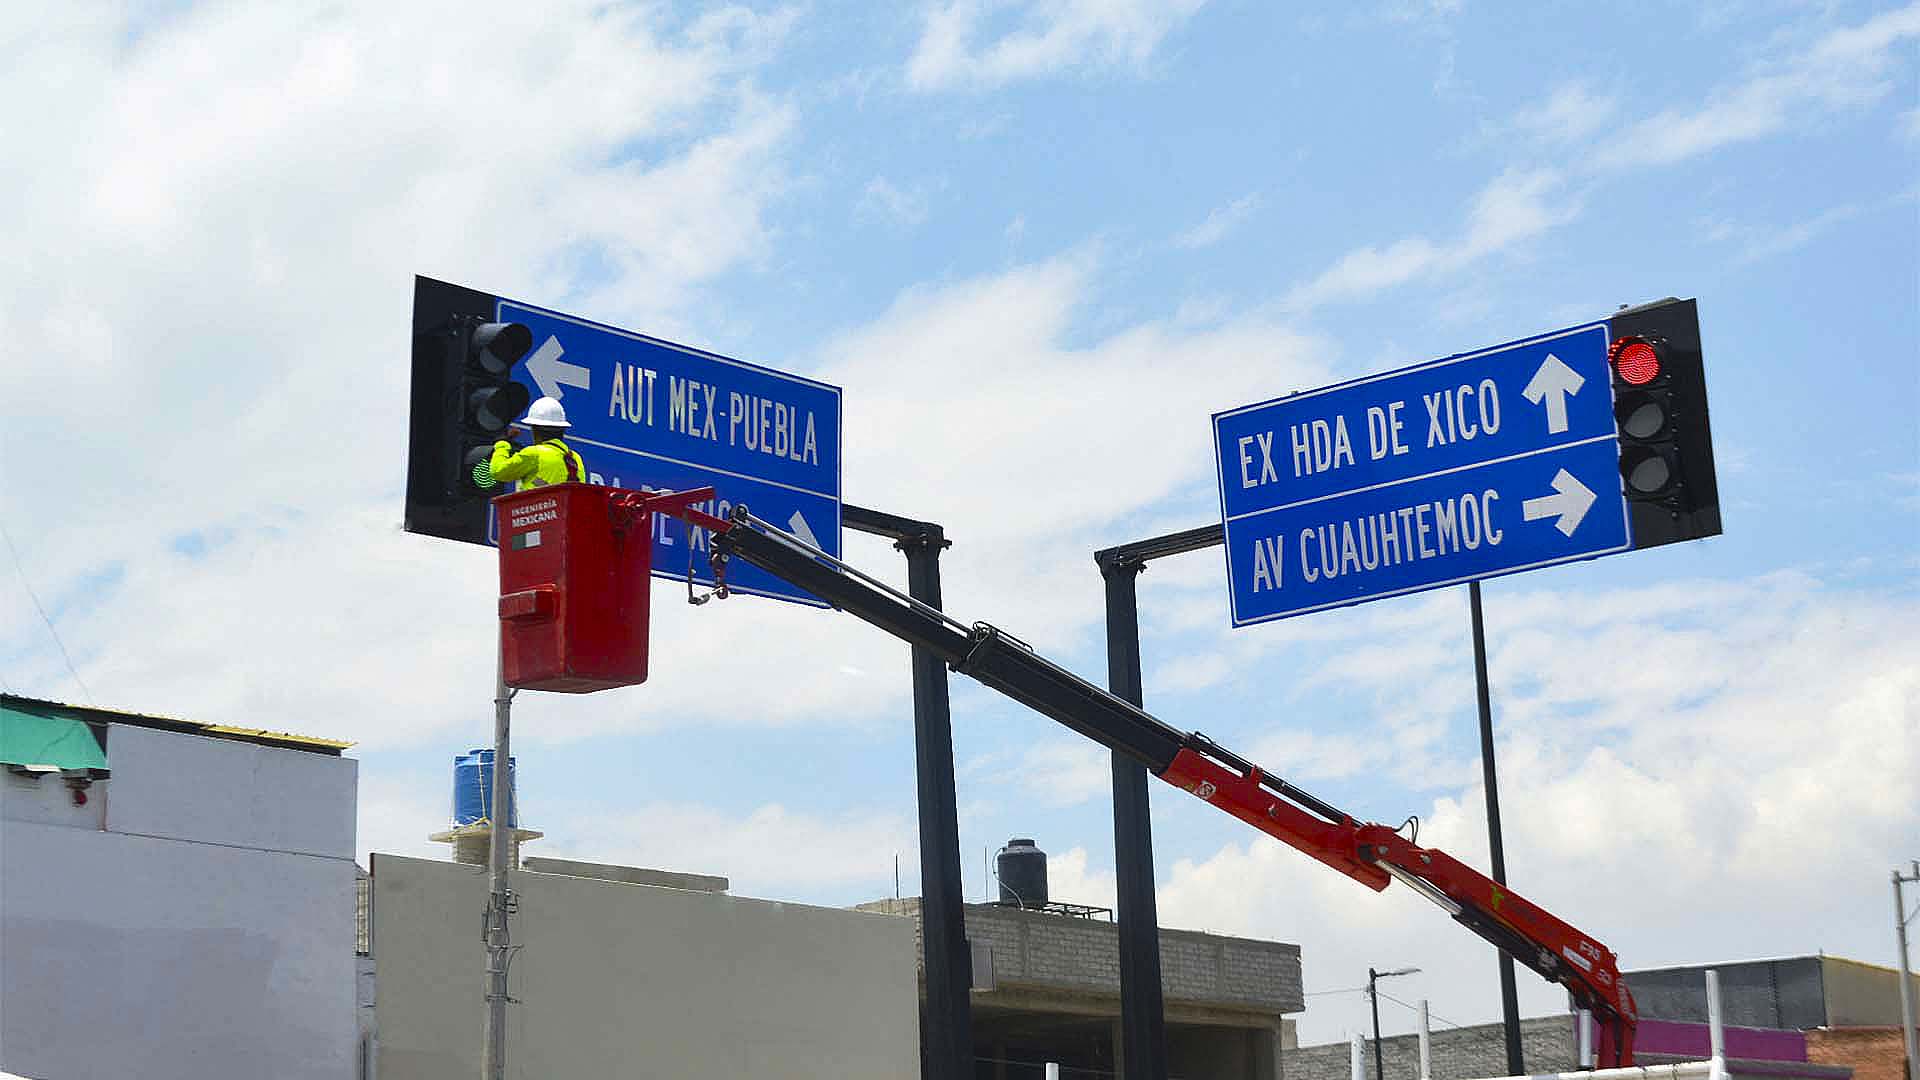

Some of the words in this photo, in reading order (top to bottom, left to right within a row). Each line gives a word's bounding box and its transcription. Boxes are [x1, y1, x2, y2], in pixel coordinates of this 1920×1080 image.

[609, 361, 657, 427] AUT
[669, 375, 819, 466] MEX-PUEBLA
[1238, 431, 1279, 489] EX
[1291, 415, 1355, 478] HDA
[1368, 401, 1410, 461] DE
[1424, 378, 1501, 449] XICO
[511, 510, 557, 528] MEXICANA
[1253, 536, 1285, 593] AV
[1300, 489, 1504, 583] CUAUHTEMOC
